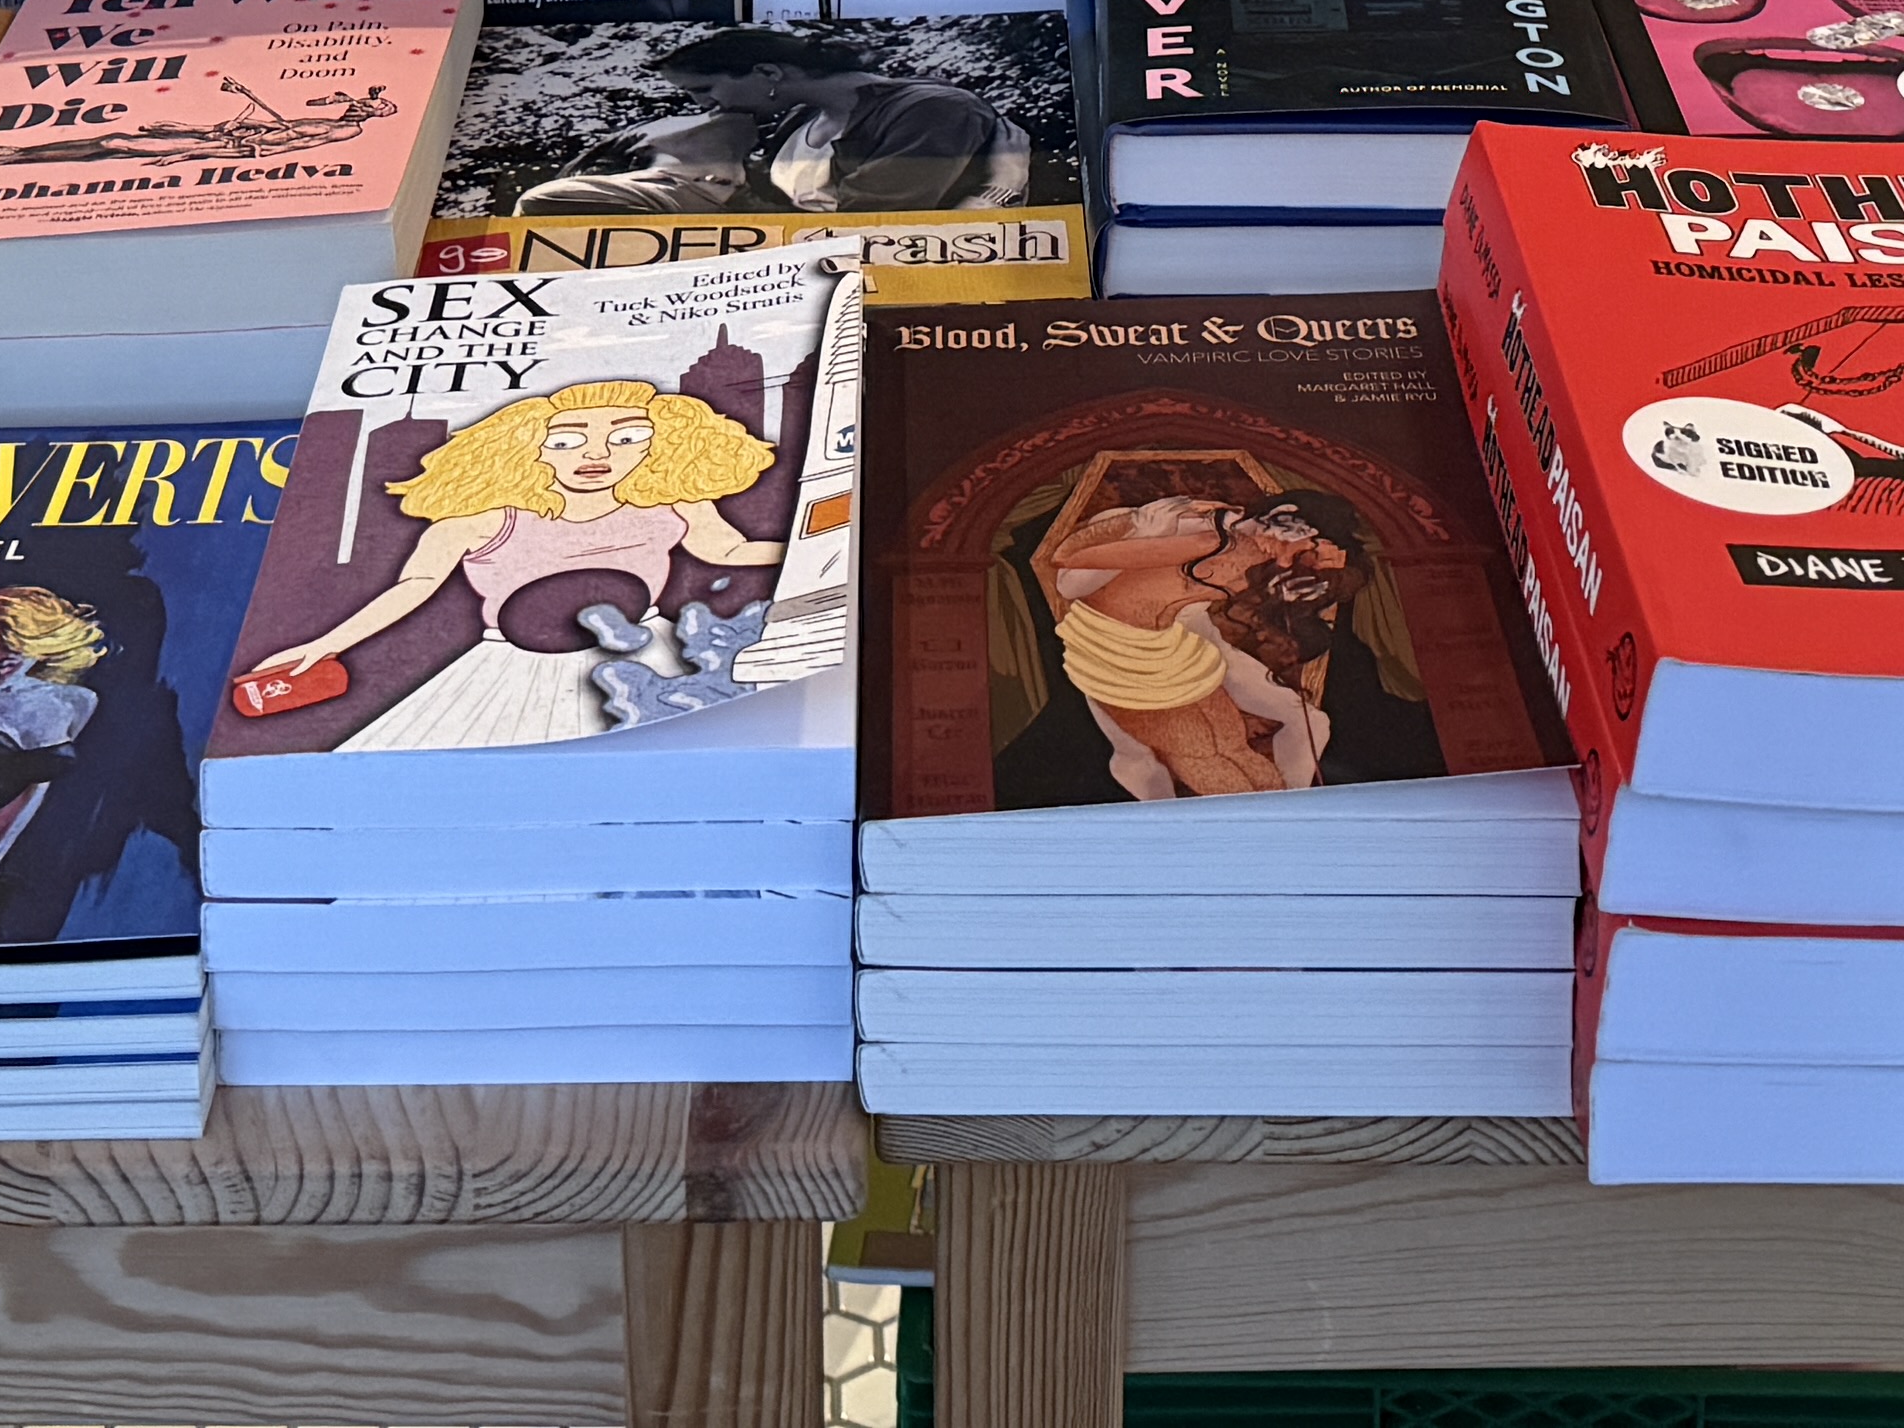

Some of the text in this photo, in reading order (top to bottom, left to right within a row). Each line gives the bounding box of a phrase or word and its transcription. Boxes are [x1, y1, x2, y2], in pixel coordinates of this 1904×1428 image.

[193, 161, 353, 187] Hedva
[360, 278, 562, 328] SEX
[593, 278, 806, 316] Tuck Woodstock
[628, 291, 804, 326] & Niko Stratis
[355, 319, 546, 346] CHANGE
[895, 313, 1418, 353] Blood, Sweat & Queers
[350, 340, 538, 366] AND THE
[341, 358, 547, 398] CITY
[1753, 550, 1895, 586] DIANE
